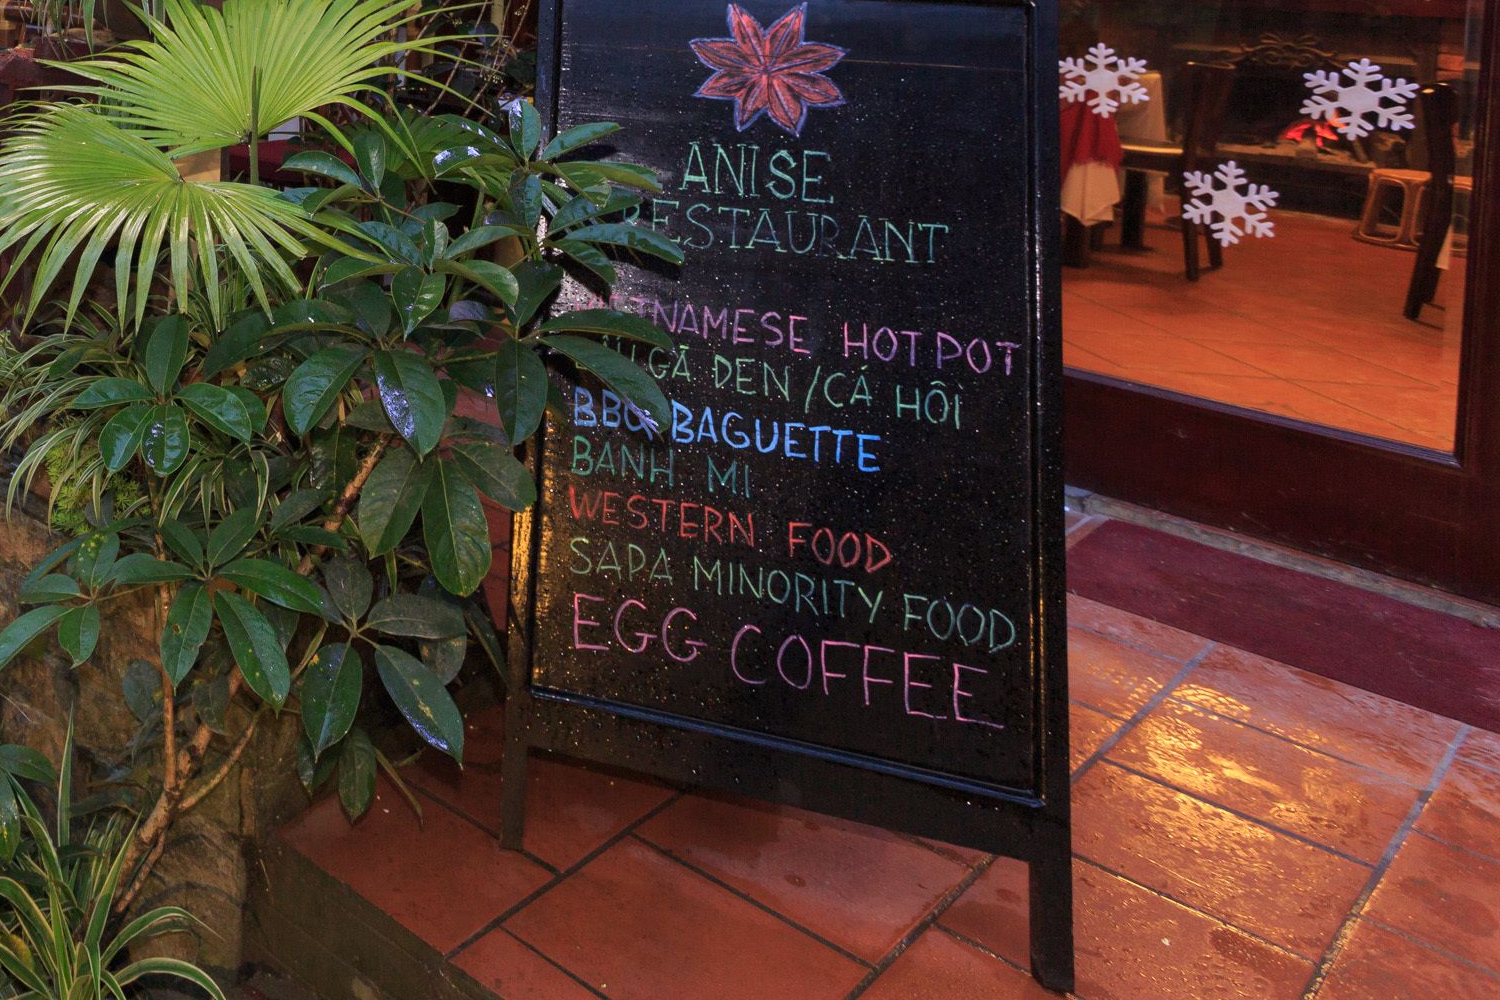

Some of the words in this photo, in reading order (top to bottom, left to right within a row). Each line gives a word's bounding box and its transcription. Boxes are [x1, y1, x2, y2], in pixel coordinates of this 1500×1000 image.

[677, 141, 834, 204] ANISE
[570, 435, 674, 487] BANH
[707, 455, 750, 498] MI
[671, 399, 881, 473] BAGUETTE
[568, 486, 755, 548] WESTERN
[789, 522, 893, 572] FOOD
[570, 536, 673, 586] SAPA
[693, 556, 884, 623] MINORITY
[904, 593, 1016, 653] FOOD
[573, 593, 708, 662] EGG
[731, 624, 1004, 729] COFFEE
